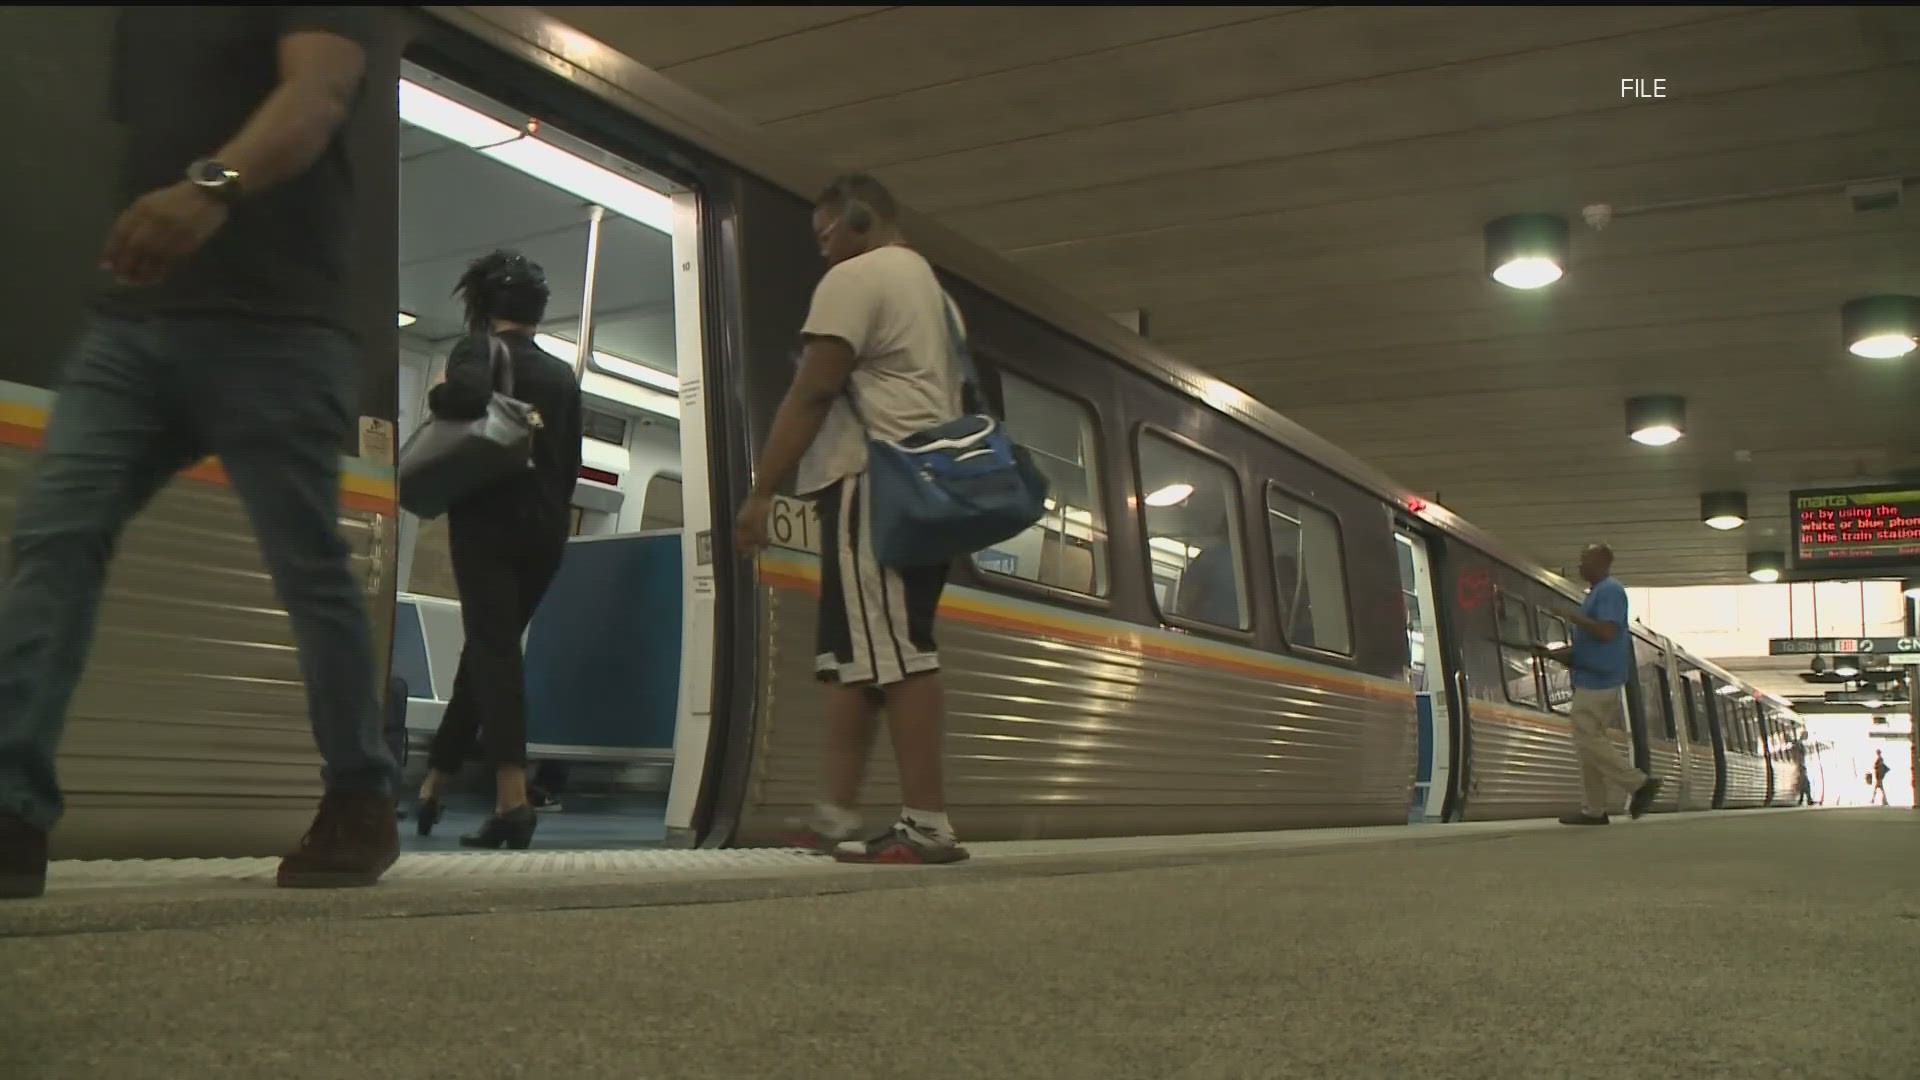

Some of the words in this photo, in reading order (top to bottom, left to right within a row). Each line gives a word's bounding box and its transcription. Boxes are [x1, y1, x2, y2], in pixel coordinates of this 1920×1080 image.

[1798, 495, 1847, 508] marta
[1801, 511, 1814, 520] or
[1819, 509, 1834, 520] by
[1839, 507, 1872, 519] using
[1876, 504, 1898, 516] the
[772, 499, 816, 548] 61
[1802, 521, 1836, 531] white
[1840, 520, 1853, 529] or
[1857, 518, 1884, 529] blue
[1802, 533, 1813, 543] in
[1817, 532, 1838, 542] the
[1842, 530, 1872, 541] train
